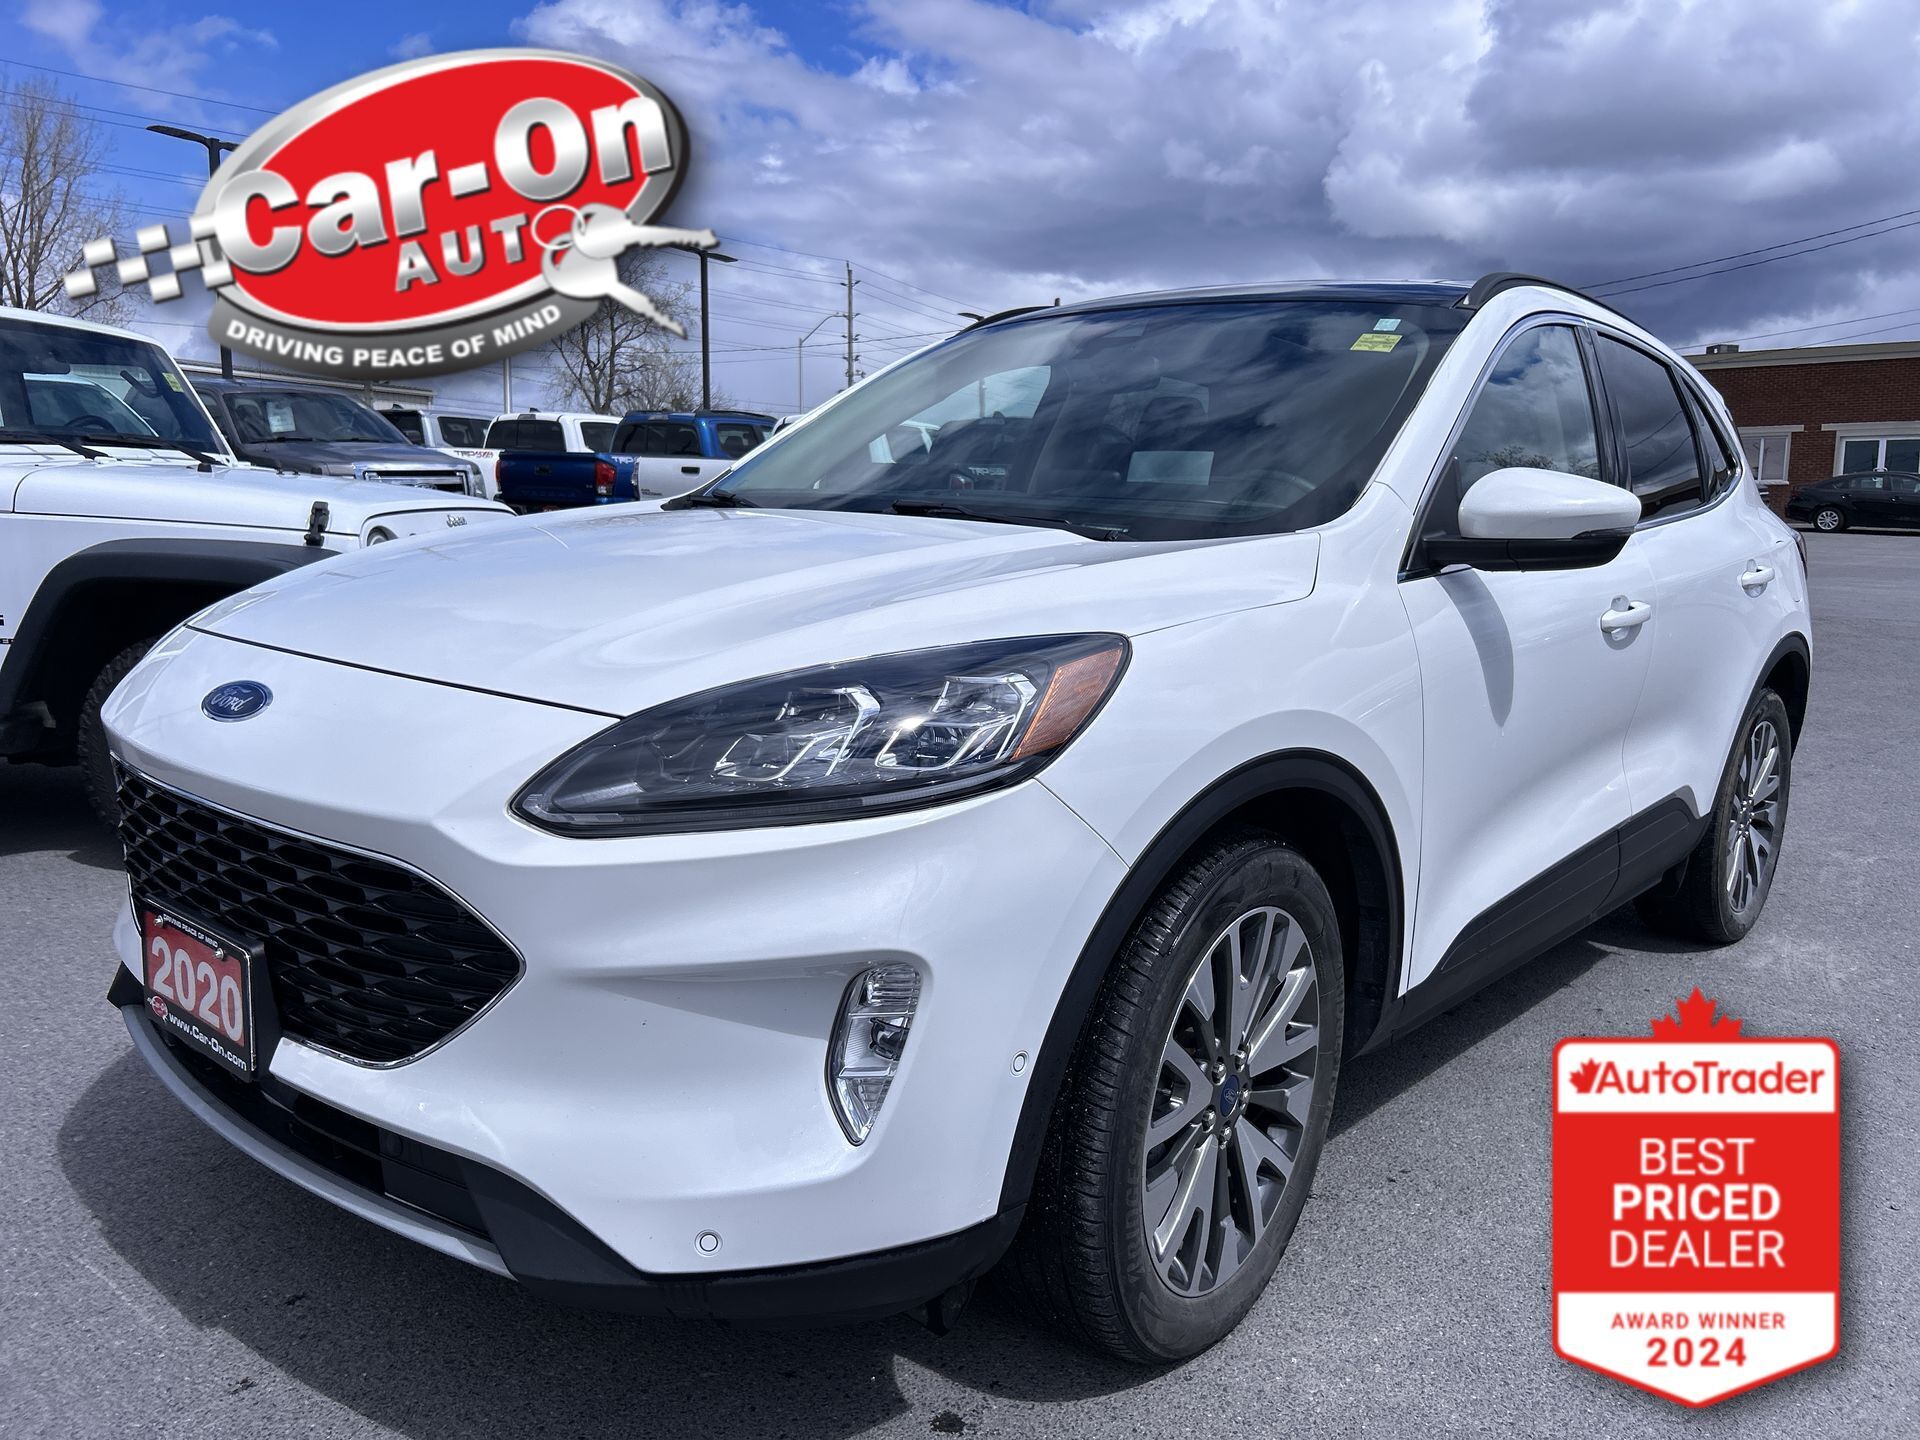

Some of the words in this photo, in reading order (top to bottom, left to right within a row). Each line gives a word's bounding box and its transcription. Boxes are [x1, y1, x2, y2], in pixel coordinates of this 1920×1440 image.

[211, 685, 254, 711] Ford
[152, 936, 244, 1042] 2020
[169, 1012, 248, 1072] www.Car-On.com
